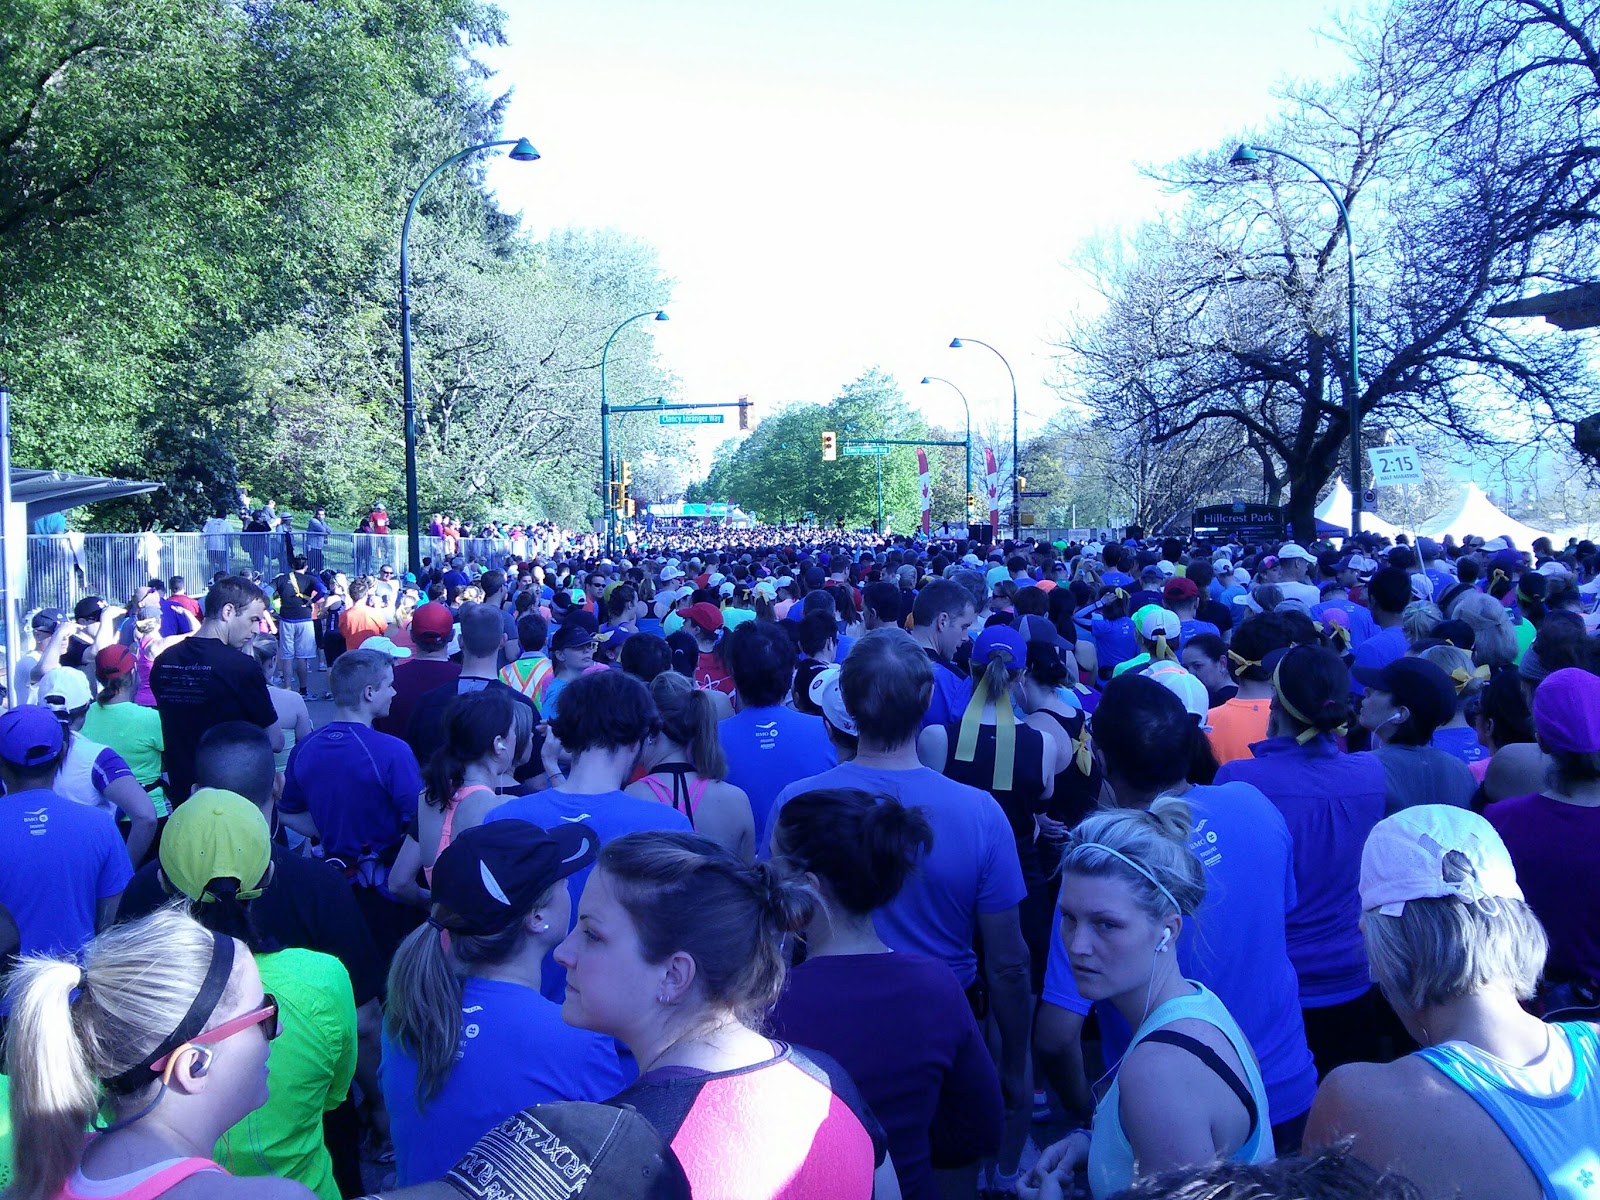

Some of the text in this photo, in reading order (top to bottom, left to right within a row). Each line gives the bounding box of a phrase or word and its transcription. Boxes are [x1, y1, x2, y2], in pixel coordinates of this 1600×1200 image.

[662, 414, 722, 424] Clancy Loranger Way
[1379, 456, 1414, 473] 2:15
[1204, 512, 1275, 523] Hillcrest Park
[535, 1135, 585, 1179] ROXY
